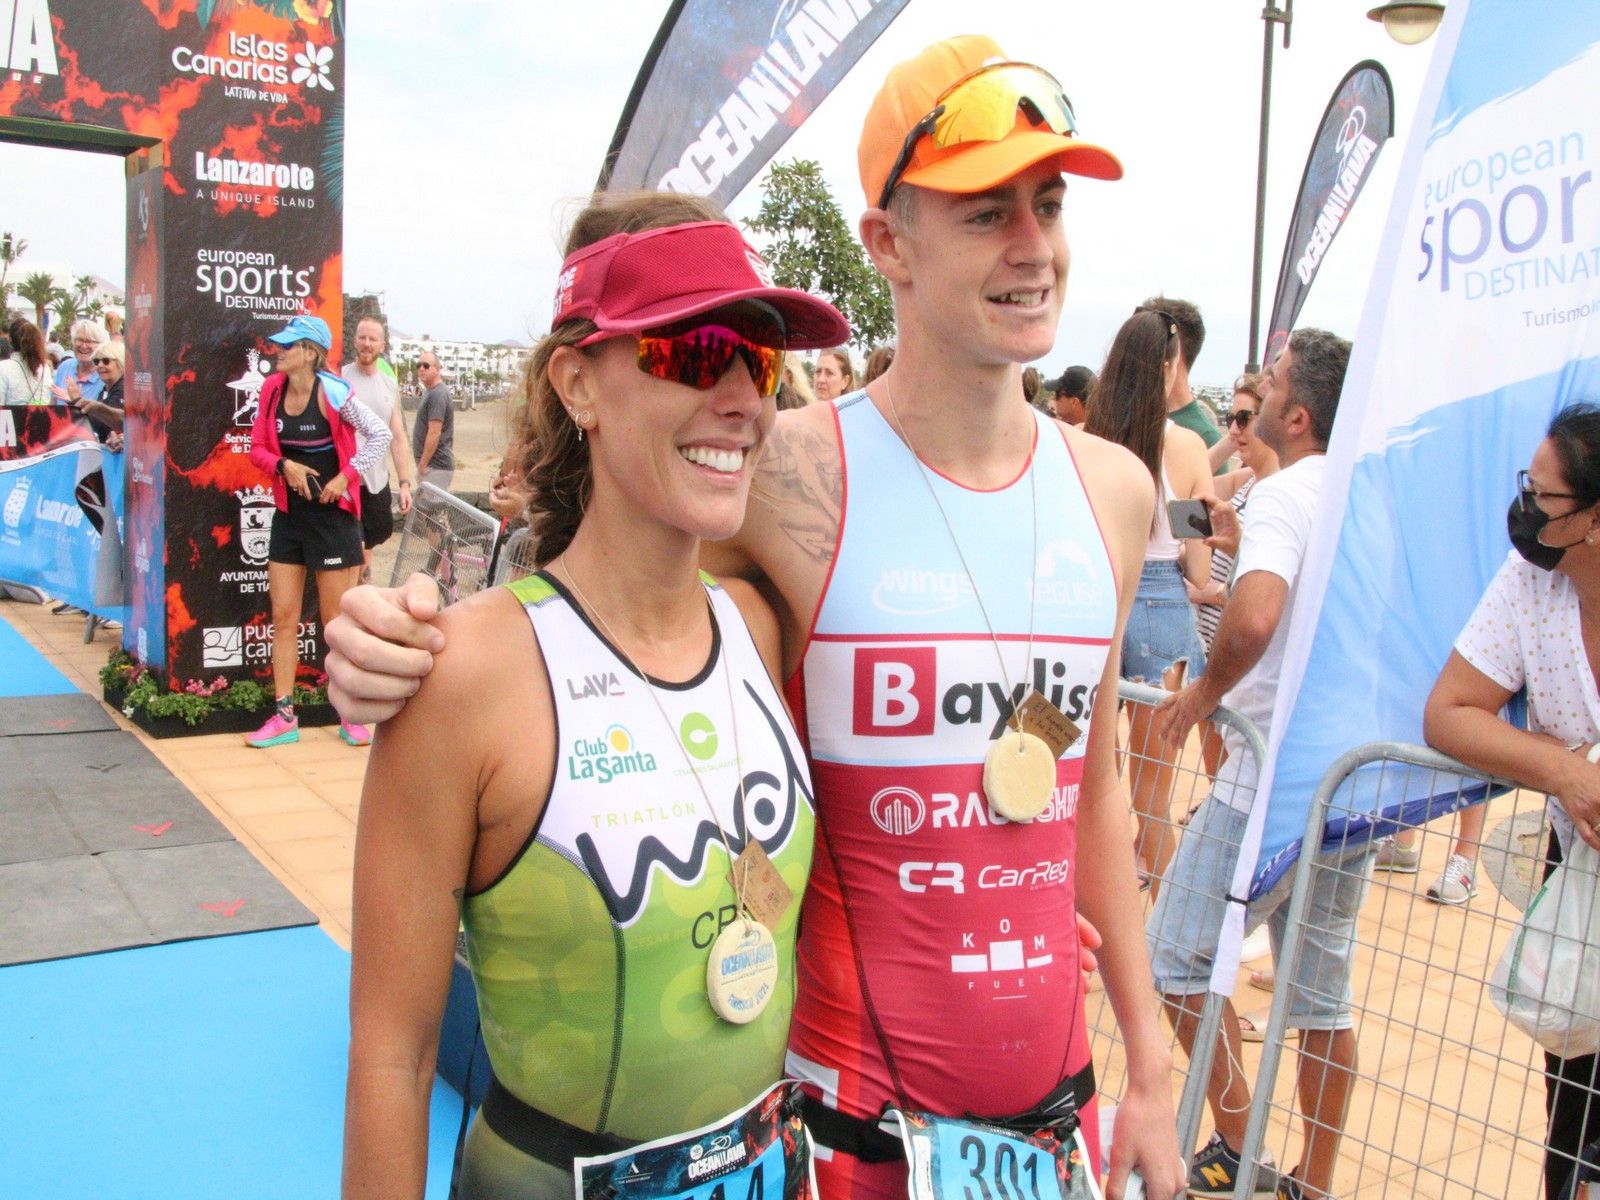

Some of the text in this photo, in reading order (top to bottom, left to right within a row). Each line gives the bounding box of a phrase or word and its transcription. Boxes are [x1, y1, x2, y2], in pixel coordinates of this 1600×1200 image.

[229, 31, 288, 62] Islas
[172, 46, 288, 85] Canarias
[224, 85, 288, 105] LATITUD DE VIDA
[195, 151, 314, 191] Lanzarote
[196, 189, 315, 209] A UNIQUE ISLAND
[197, 248, 275, 269] european
[196, 265, 311, 303] sports
[225, 295, 304, 311] DESTINATION
[225, 433, 252, 444] Servic
[232, 445, 243, 454] de
[220, 571, 270, 582] AYUNTAM
[240, 580, 271, 593] DE TÍA
[881, 565, 980, 602] wings
[245, 639, 316, 658] caren
[567, 672, 625, 700] LAVA
[574, 739, 608, 757] Club
[591, 801, 697, 829] TRIATLÓN
[899, 859, 1069, 894] CR CarReg
[968, 975, 1046, 991] FUEL
